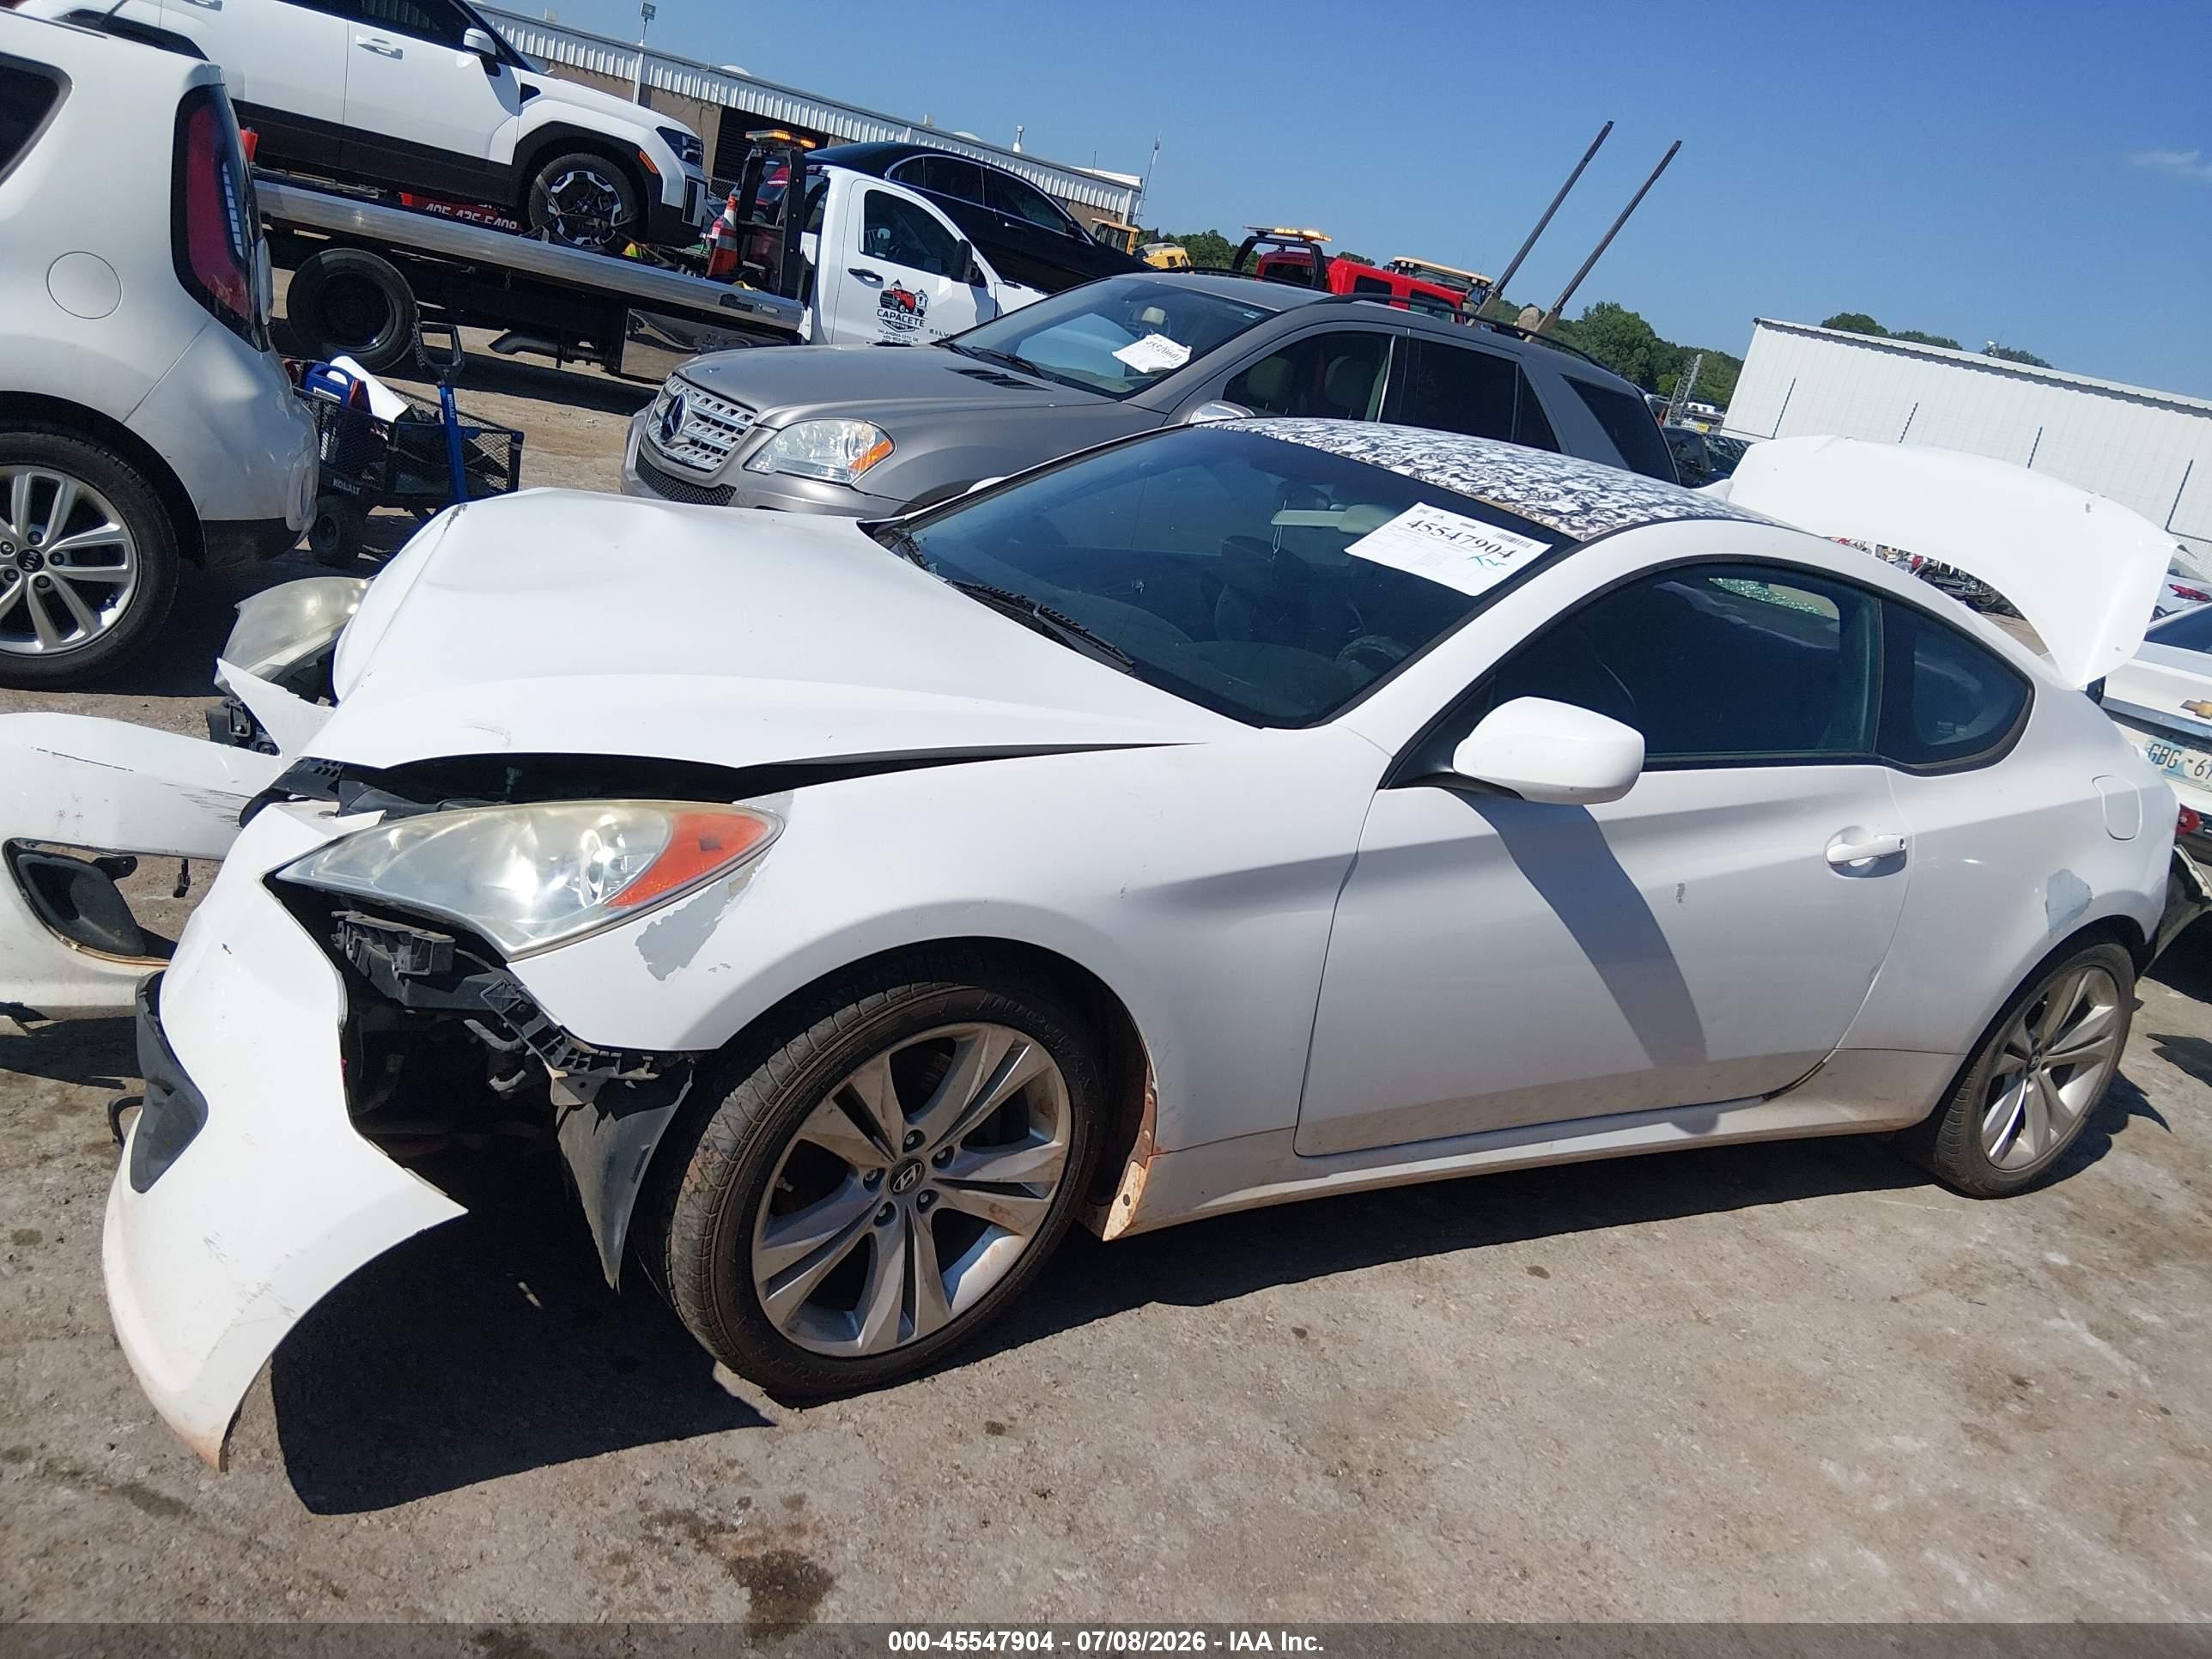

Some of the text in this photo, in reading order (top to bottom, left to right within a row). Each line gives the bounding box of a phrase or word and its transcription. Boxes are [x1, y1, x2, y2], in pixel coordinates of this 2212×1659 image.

[877, 308, 926, 328] CAPACETE
[447, 393, 456, 420] KOBALT
[333, 477, 361, 495] KOBALT
[1406, 520, 1517, 558] 45547904
[23, 551, 39, 570] KIA
